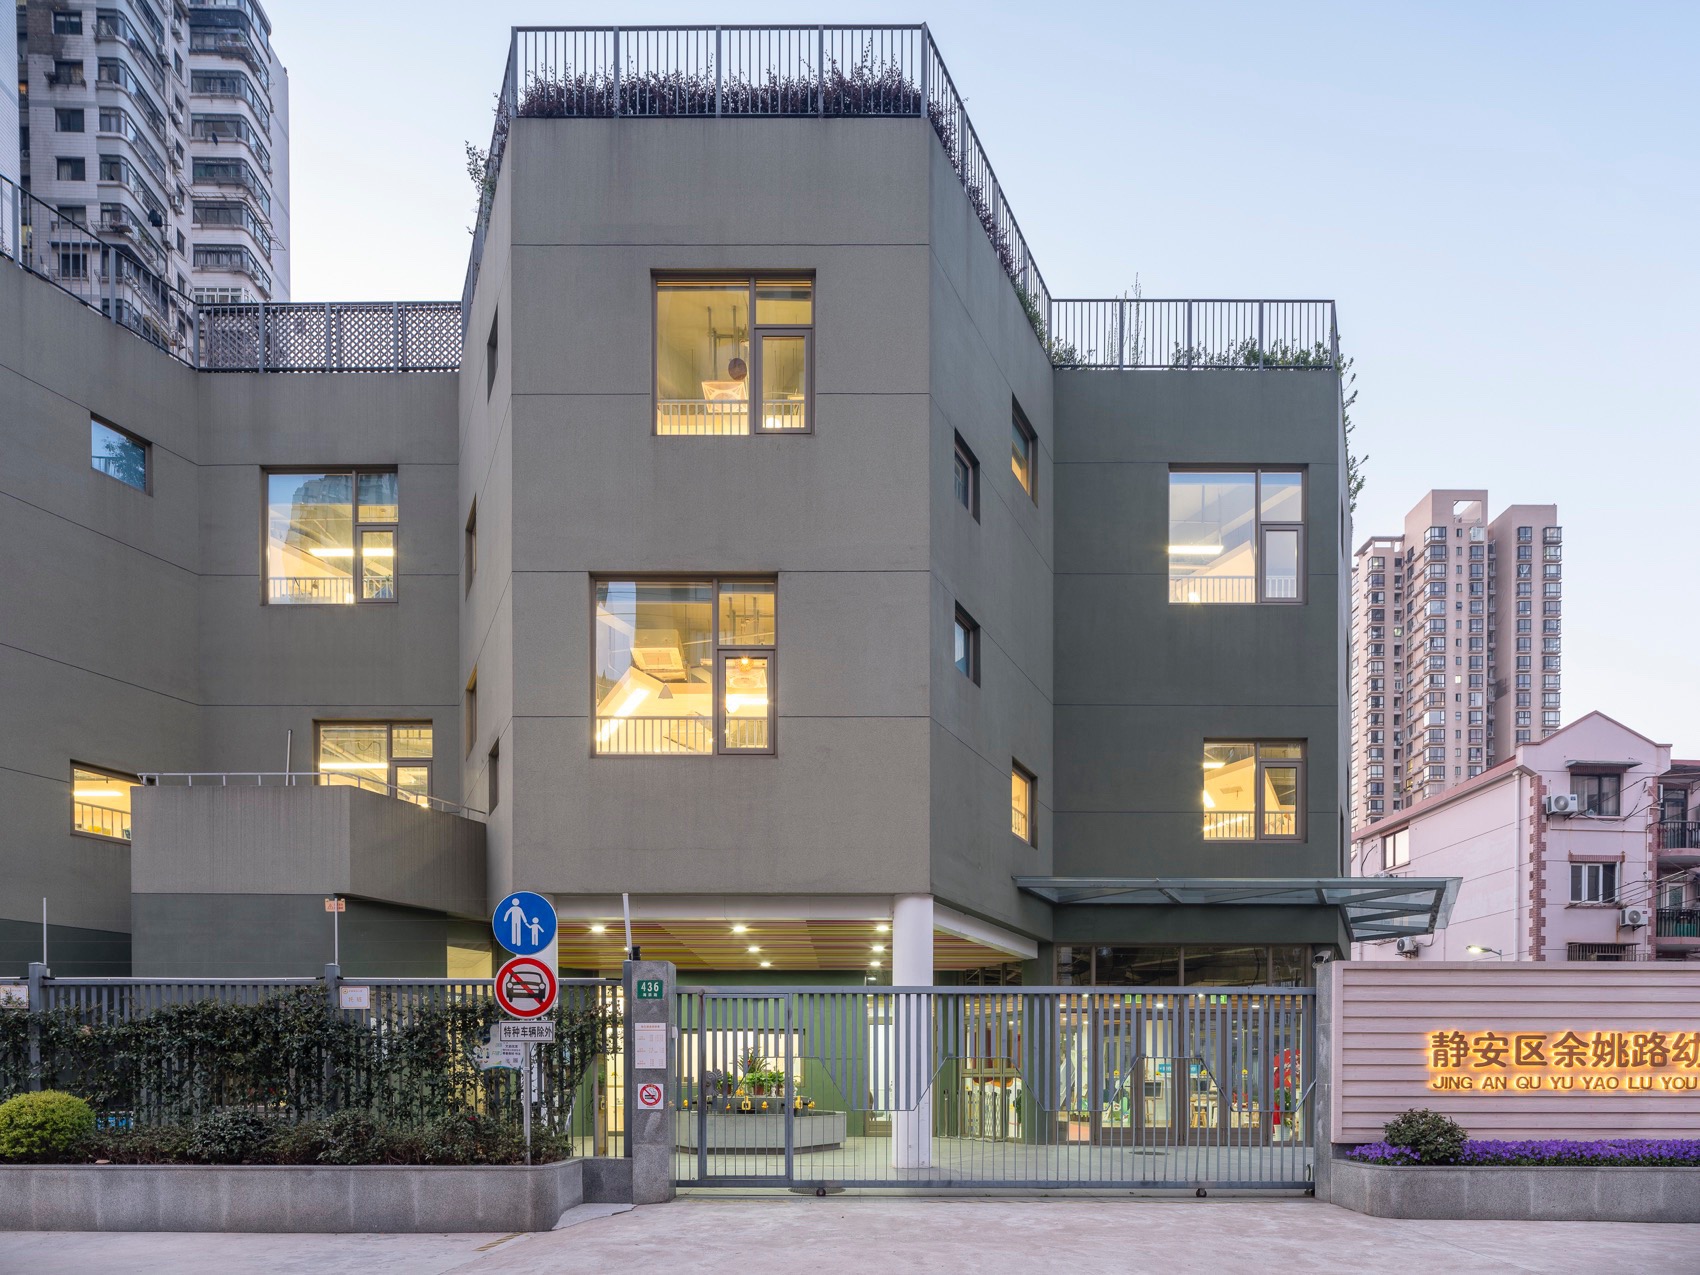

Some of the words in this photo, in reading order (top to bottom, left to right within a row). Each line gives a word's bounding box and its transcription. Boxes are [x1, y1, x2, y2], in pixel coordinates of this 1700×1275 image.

[641, 981, 659, 992] 436
[503, 1025, 553, 1038] 特种车辆除外
[1431, 1031, 1700, 1068] 静安区余姚路幼
[1432, 1076, 1473, 1090] JING
[1481, 1076, 1507, 1090] AN
[1515, 1076, 1542, 1090] QU
[1549, 1076, 1574, 1090] YU
[1581, 1076, 1620, 1090] YAO
[1627, 1076, 1653, 1090] LU
[1660, 1076, 1698, 1090] YOU
